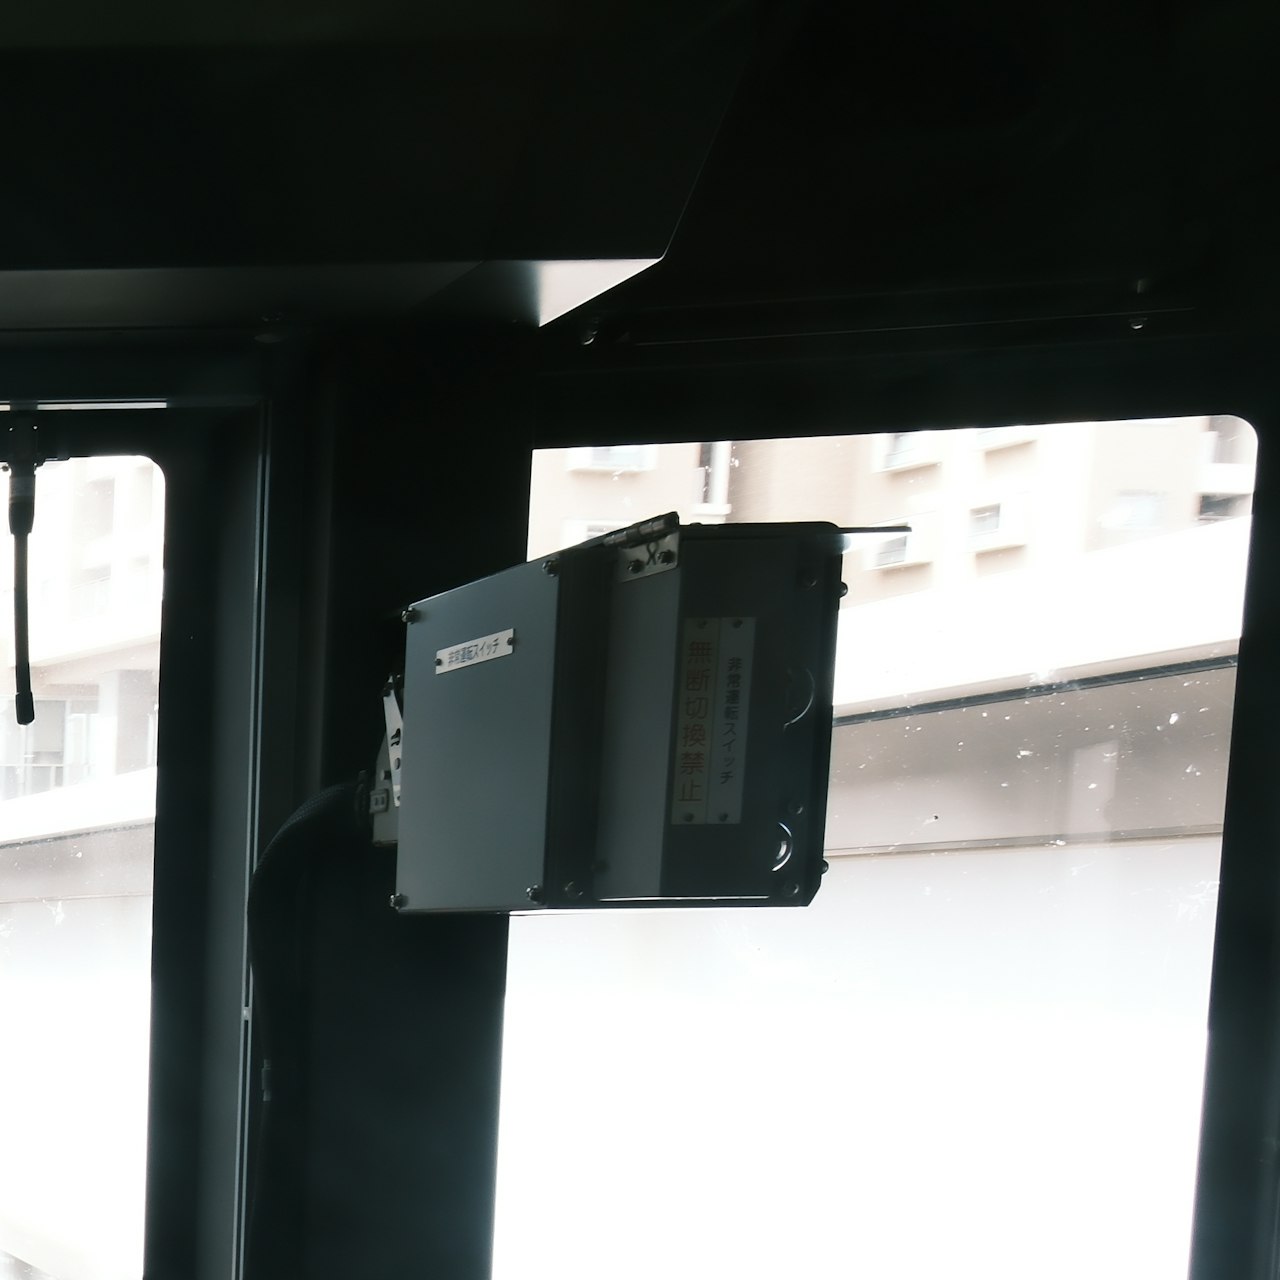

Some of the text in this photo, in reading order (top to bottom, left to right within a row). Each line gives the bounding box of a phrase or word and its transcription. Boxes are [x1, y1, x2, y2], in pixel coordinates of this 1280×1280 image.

[448, 638, 500, 665] 非常運転スイッチ
[678, 640, 712, 803] 無断切換禁止
[719, 656, 743, 786] 非常運転スイッチ
